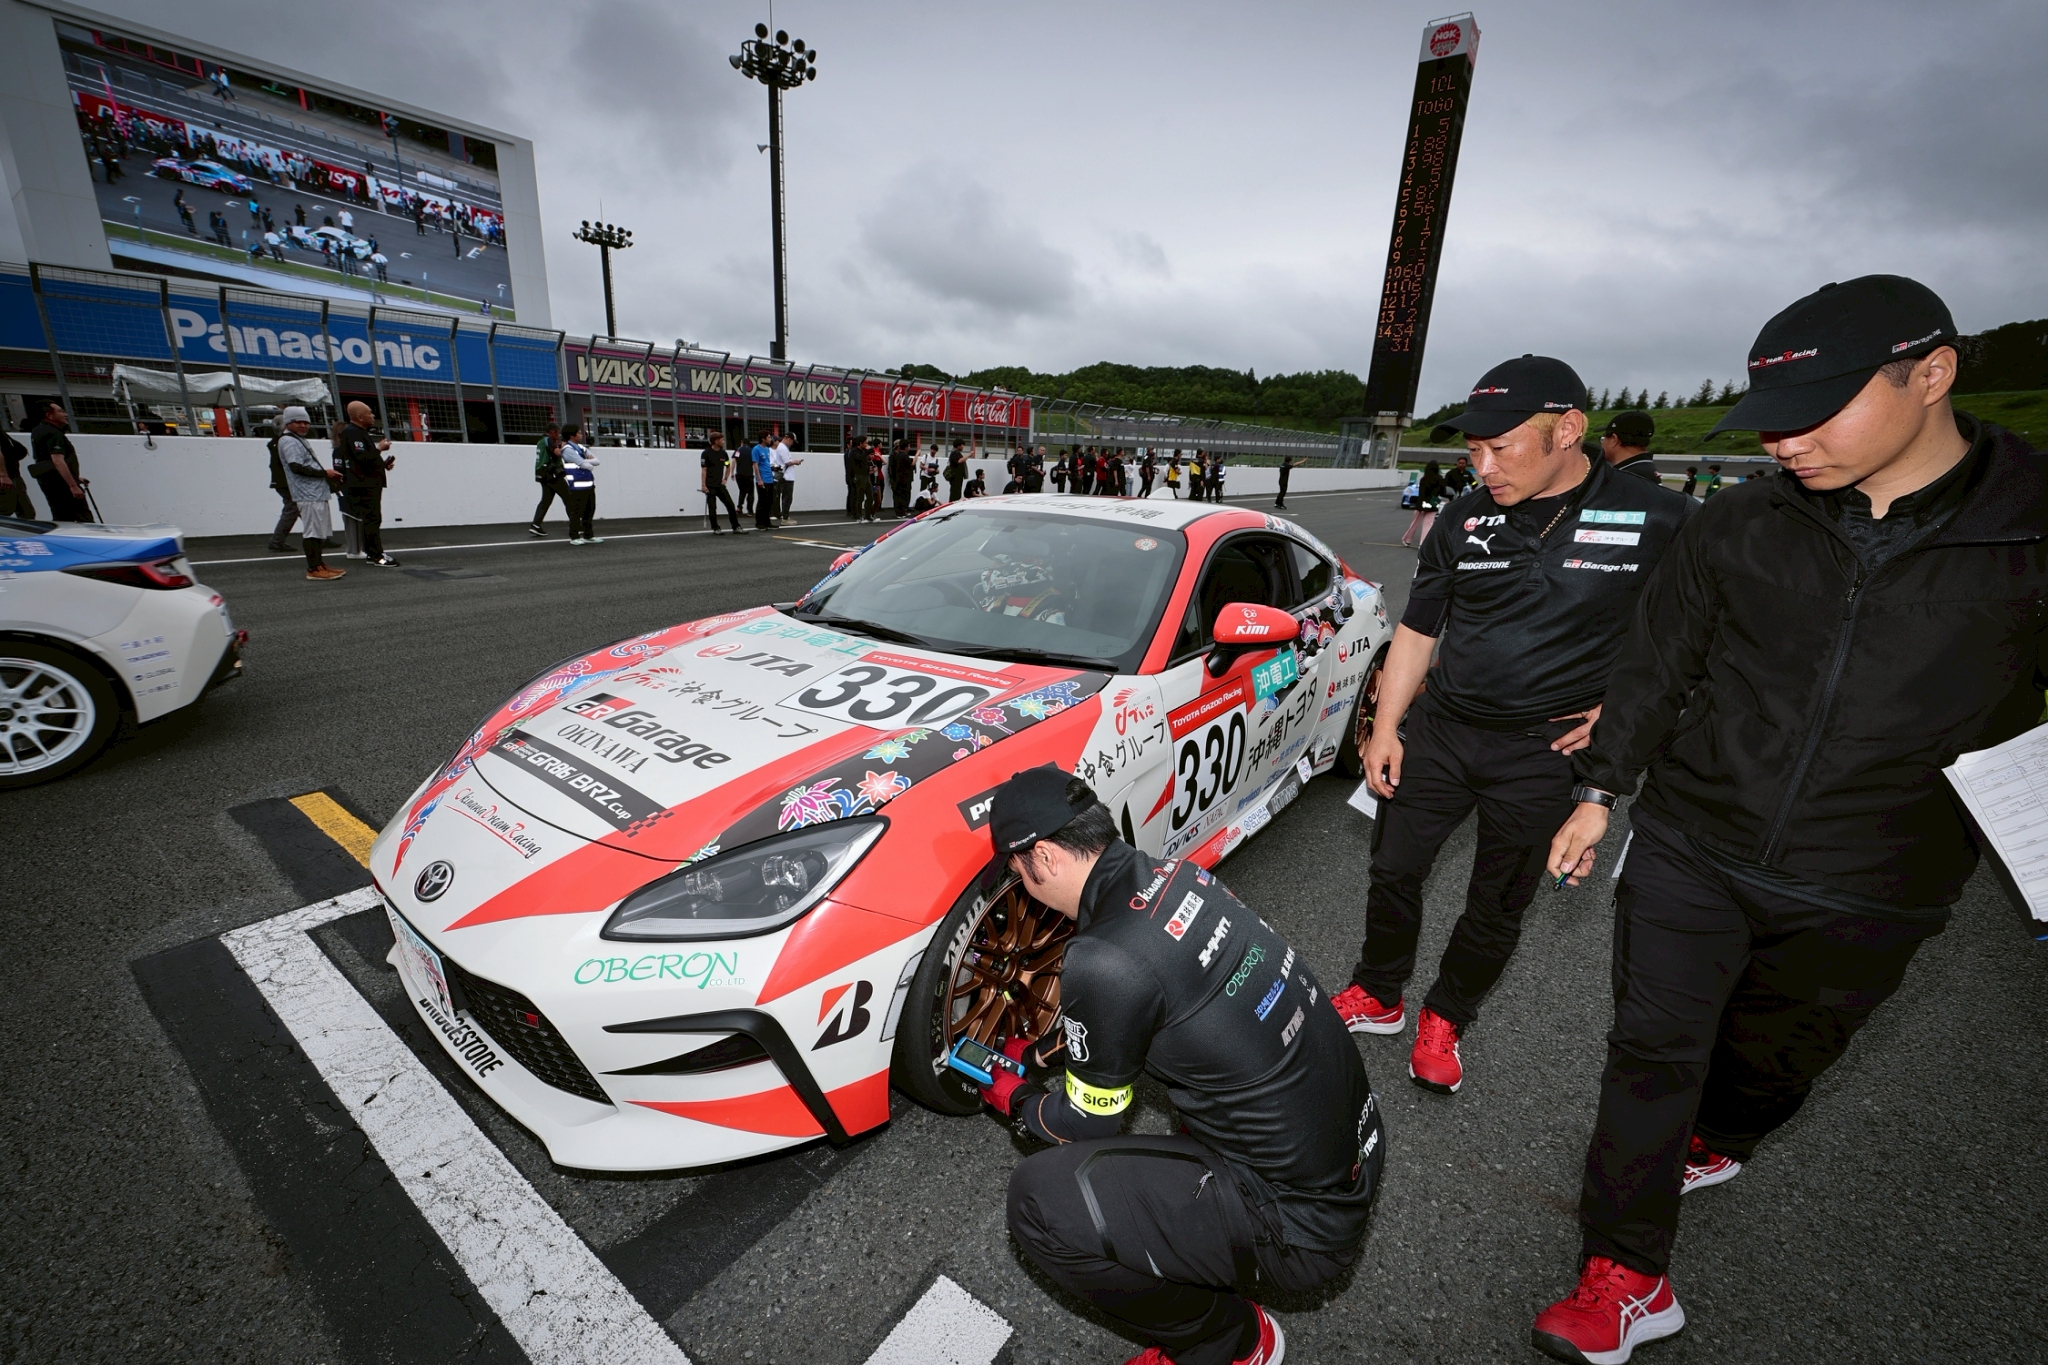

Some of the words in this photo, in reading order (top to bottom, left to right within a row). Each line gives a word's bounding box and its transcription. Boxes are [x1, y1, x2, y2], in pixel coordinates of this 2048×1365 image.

[1435, 29, 1457, 42] NGK
[1413, 124, 1419, 138] 1
[1409, 140, 1419, 154] 2
[1407, 156, 1417, 170] 3
[1404, 172, 1413, 186] 4
[1401, 188, 1412, 202] 5
[1399, 204, 1408, 218] 6
[1398, 219, 1407, 233] 7
[1394, 235, 1403, 248] 8
[1392, 251, 1401, 263] 9
[1387, 265, 1402, 279] 10
[1384, 281, 1398, 294] 11
[1382, 296, 1397, 309] 12
[1380, 310, 1395, 323] 13
[169, 308, 441, 371] Panasonic
[1378, 325, 1392, 338] 14
[1783, 348, 1818, 363] Racing
[576, 355, 679, 391] WAKO'S
[690, 368, 773, 399] WAKO'S
[887, 386, 943, 417] Coca-Cola
[968, 396, 1010, 423] Coca-Cola
[1477, 515, 1506, 527] JTA
[1598, 513, 1642, 523] 沖電工
[1457, 561, 1511, 570] BRIDGESTONE
[1581, 562, 1621, 573] Garage
[771, 626, 880, 656] 沖電工
[1349, 636, 1371, 657] JTA
[726, 652, 816, 677] JTA
[871, 654, 920, 668] TOYOTA
[920, 663, 966, 677] GAZOO
[966, 671, 1013, 687] Racing
[1256, 656, 1295, 697] 沖電工
[798, 665, 991, 726] 330
[667, 680, 819, 738] 沖食グループ
[1172, 711, 1200, 729] TOYOTA
[1200, 697, 1223, 714] GAZOO
[1223, 687, 1242, 702] Racing
[564, 699, 617, 721] GR
[602, 710, 732, 770] Garage
[1245, 677, 1317, 783] 沖縄トヨタ
[557, 723, 650, 774] OKINAWA
[1075, 719, 1164, 786] 沖食グループ
[1172, 711, 1246, 831] 330
[607, 802, 632, 821] Cup
[1248, 806, 1267, 823] OGURA
[1251, 812, 1270, 829] CLUTCH
[1211, 827, 1242, 856] FUJITSUBO
[574, 951, 738, 990] OBERON
[1225, 943, 1264, 997] OBERON
